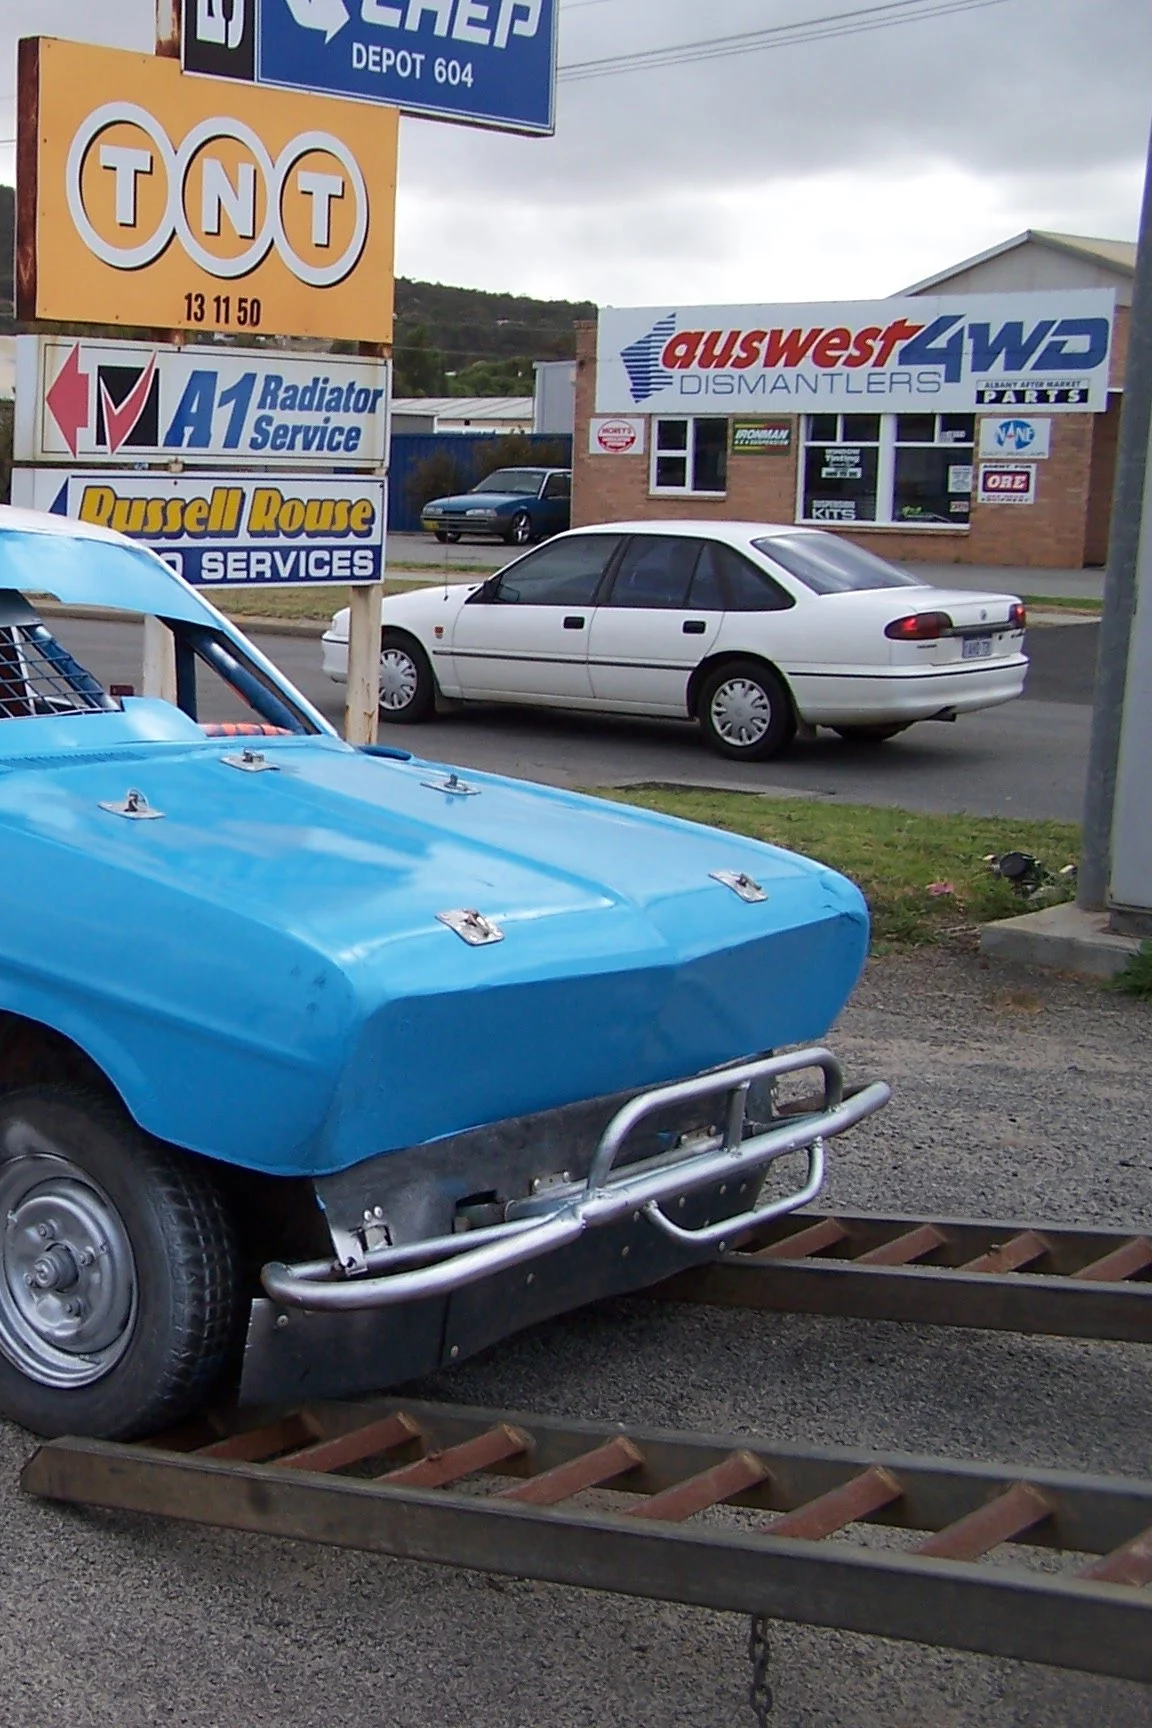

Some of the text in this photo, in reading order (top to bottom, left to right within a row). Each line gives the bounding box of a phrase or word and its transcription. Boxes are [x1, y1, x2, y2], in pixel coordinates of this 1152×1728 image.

[352, 42, 474, 88] DEPOT 604
[99, 143, 345, 247] TNT
[184, 292, 262, 327] 13 11 50
[660, 313, 1111, 384] auswest 4WD
[679, 372, 944, 396] DISMANTLERS
[983, 389, 1082, 403] PARTS
[163, 369, 384, 450] A1 Radiator
[249, 414, 362, 453] Service
[734, 429, 790, 440] IRONMAN
[987, 475, 1027, 489] ORE
[78, 485, 375, 541] Russell Rouse
[811, 508, 856, 522] KITS
[201, 549, 374, 580] SERVICES
